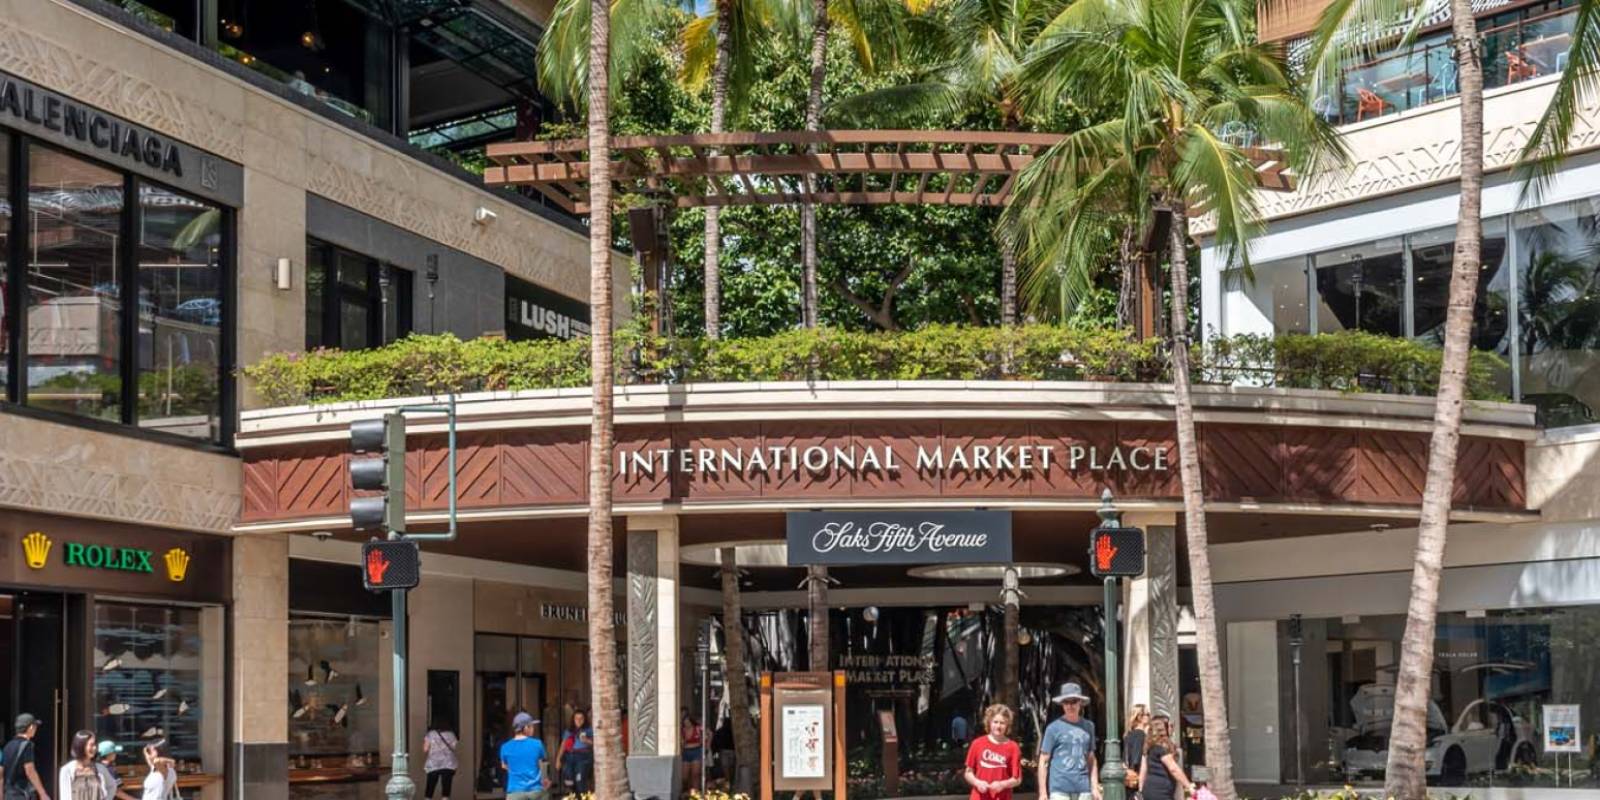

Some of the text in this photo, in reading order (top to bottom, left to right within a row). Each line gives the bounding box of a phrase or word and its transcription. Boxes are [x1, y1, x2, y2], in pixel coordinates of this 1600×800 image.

[521, 299, 570, 339] LUSH
[619, 444, 1168, 474] INTERNATIONAL MARKET PLACE
[812, 521, 988, 553] Saks Fifth Avenue
[66, 542, 153, 572] ROLEX
[839, 654, 939, 668] INTERATIONL
